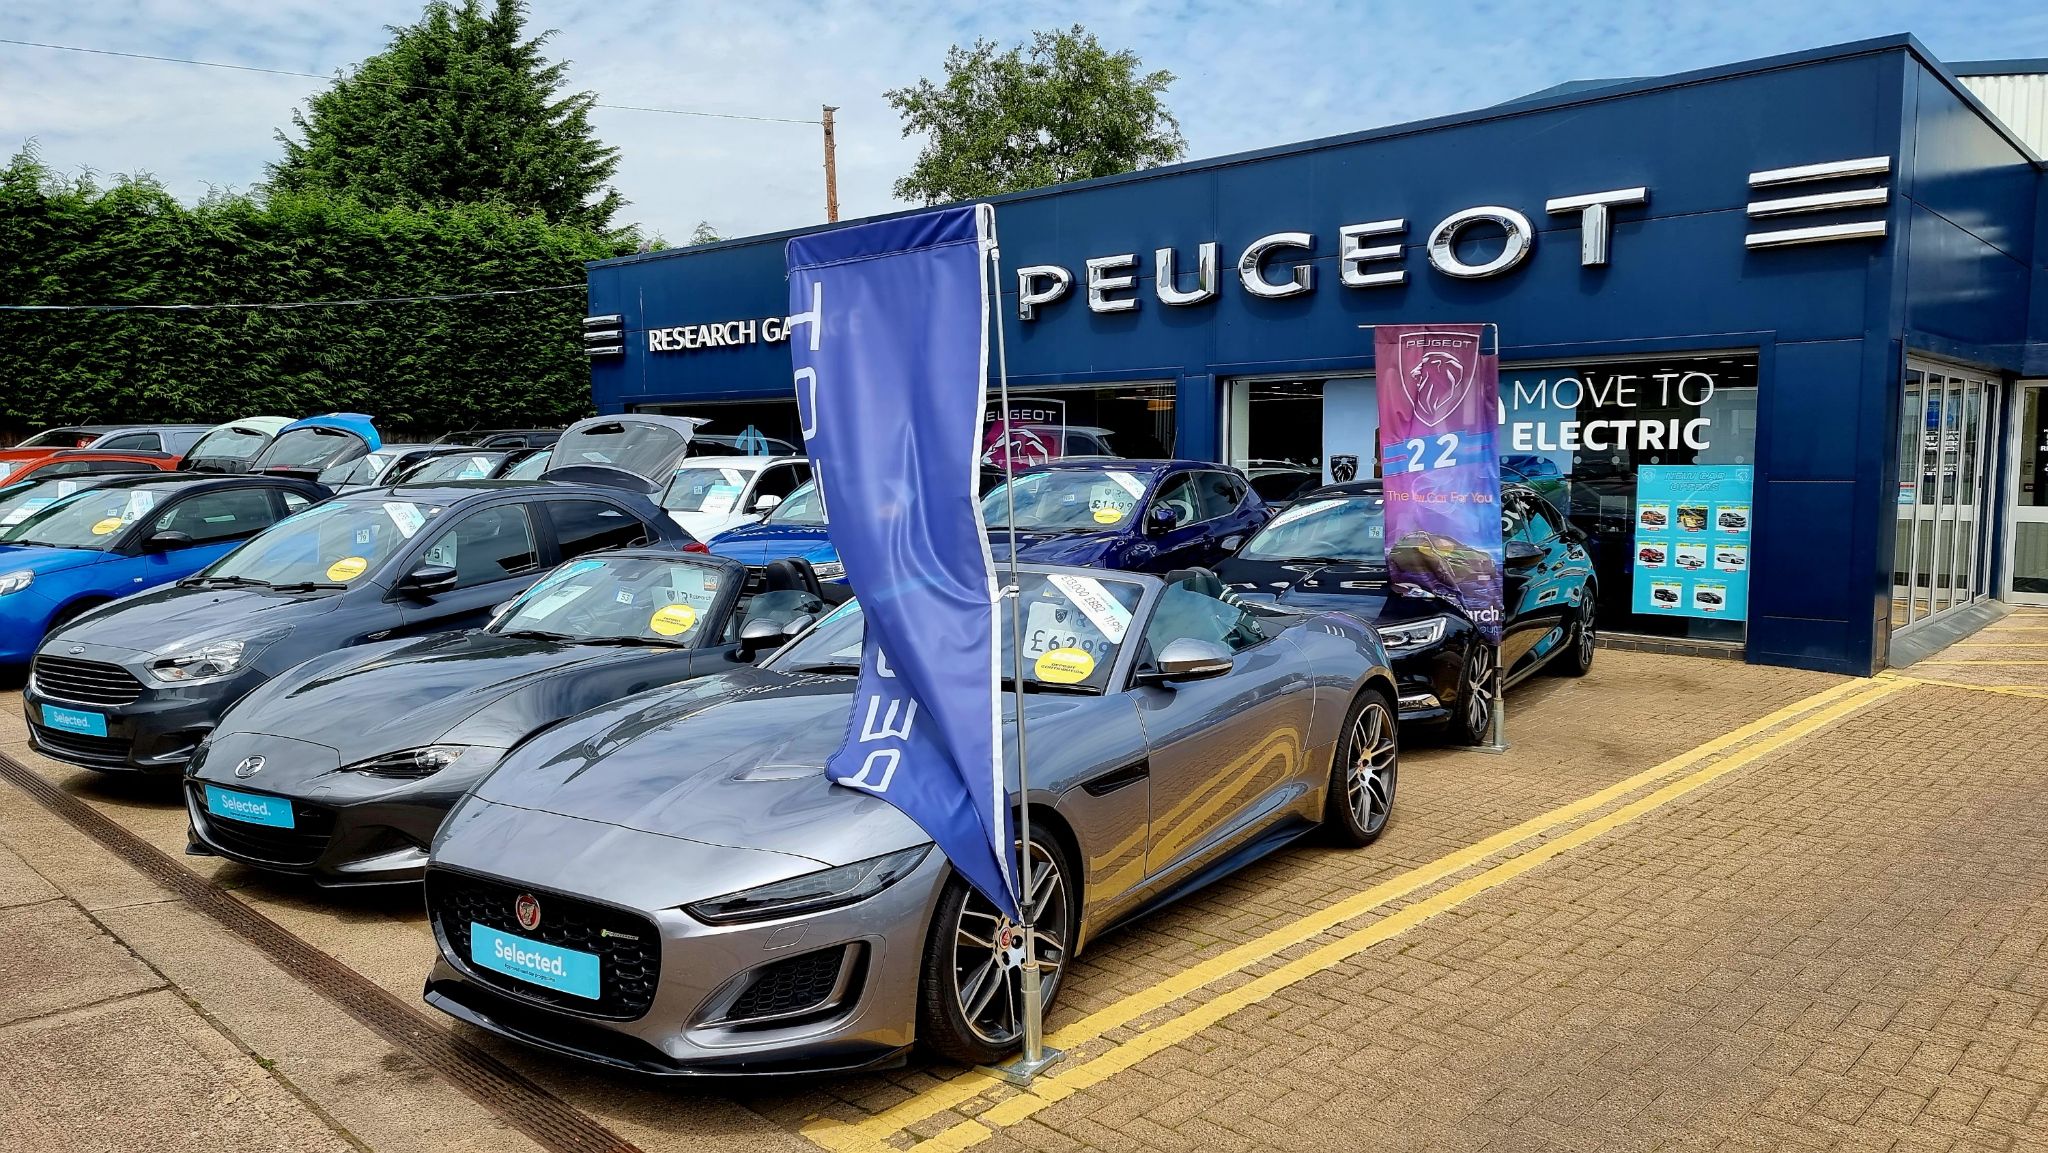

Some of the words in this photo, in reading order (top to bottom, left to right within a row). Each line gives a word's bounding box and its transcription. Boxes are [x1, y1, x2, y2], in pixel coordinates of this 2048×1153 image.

[1016, 187, 1646, 320] PEUGEOT
[648, 319, 756, 352] RESEARCH
[1406, 339, 1472, 349] PEUGEOT
[1513, 375, 1638, 411] MOVE
[1652, 372, 1714, 406] TO
[1512, 417, 1712, 451] ELECTRIC
[1386, 490, 1409, 502] The
[1471, 491, 1493, 504] You
[220, 794, 272, 817] Selected.
[494, 937, 568, 977] Selected.
